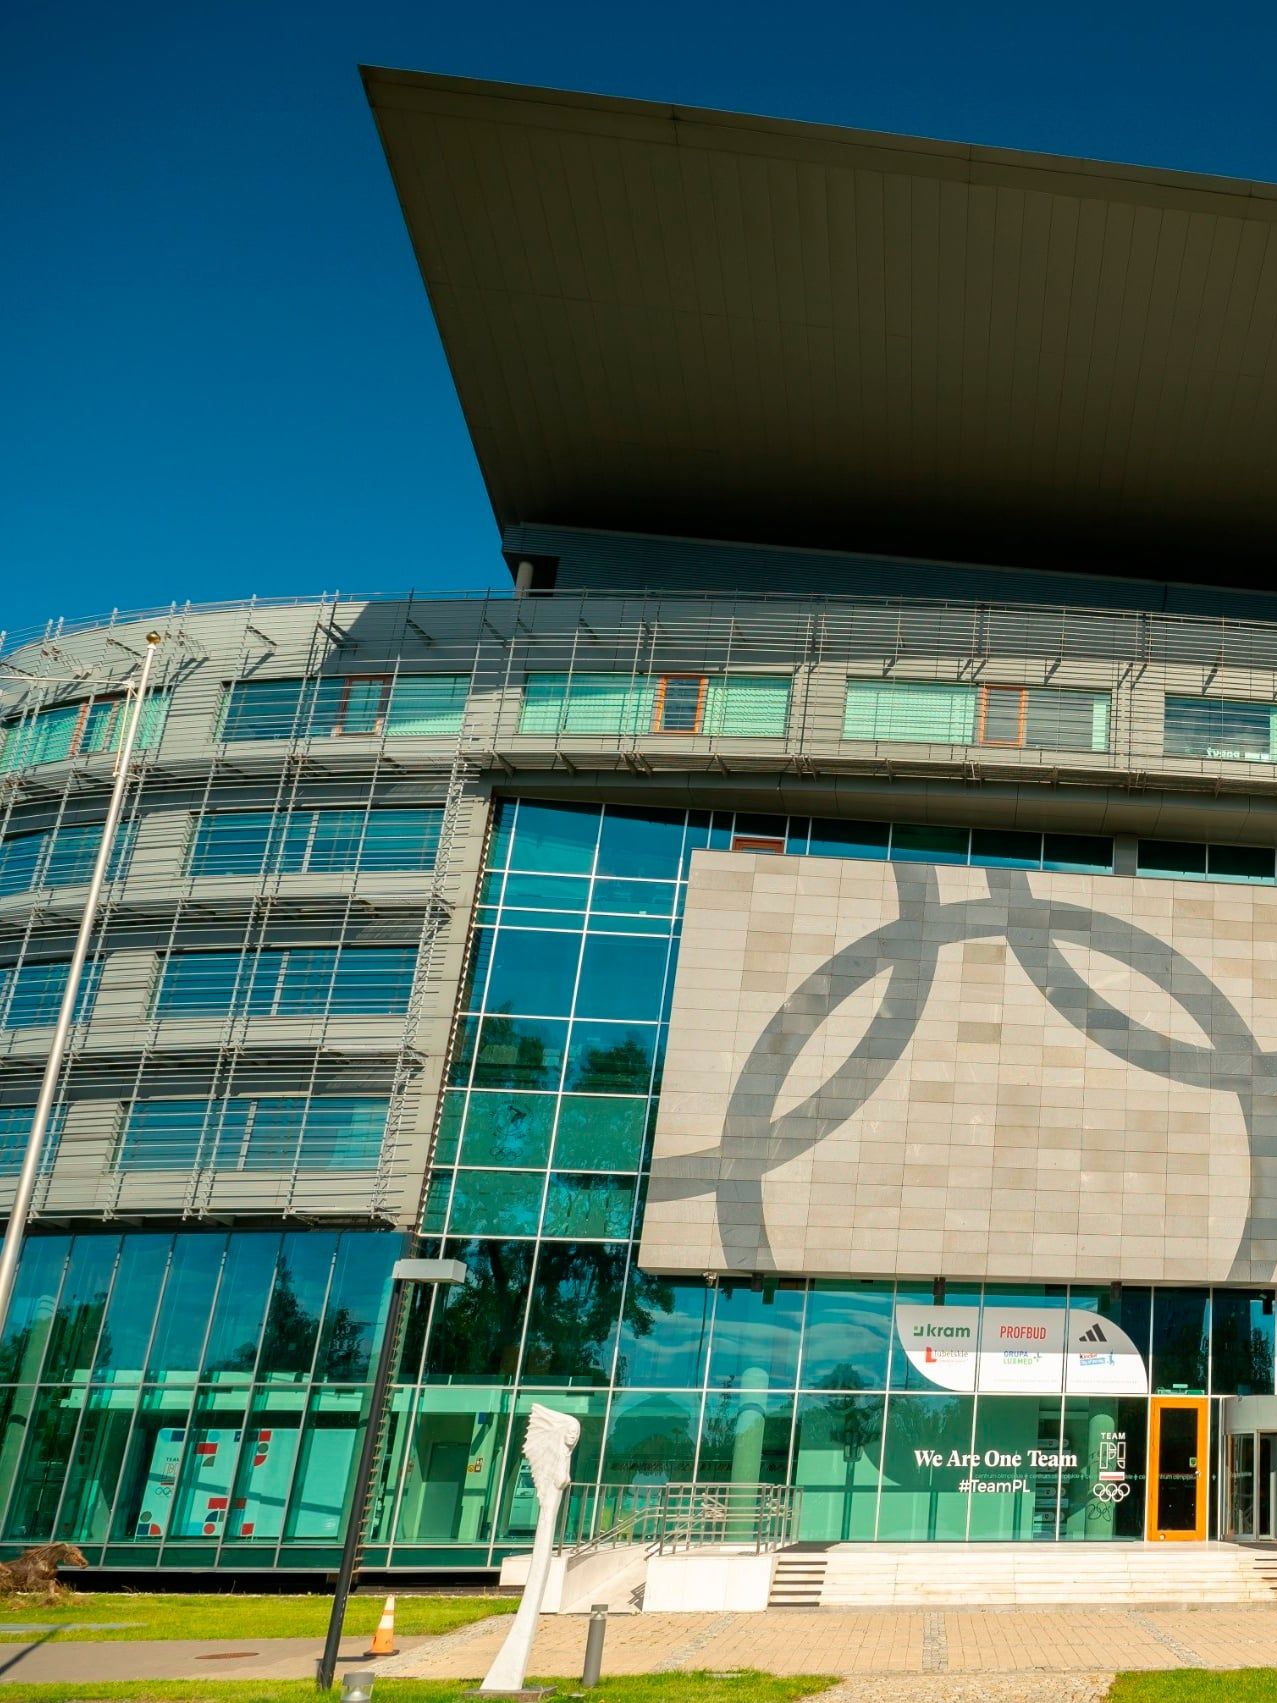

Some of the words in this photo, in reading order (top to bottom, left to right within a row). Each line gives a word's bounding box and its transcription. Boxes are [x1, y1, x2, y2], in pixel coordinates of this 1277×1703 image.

[1000, 1325, 1047, 1340] PROFBUD
[1101, 1432, 1126, 1440] TEAM
[914, 1450, 943, 1468] We
[946, 1450, 980, 1468] Are
[984, 1450, 1022, 1468] One
[1027, 1450, 1078, 1468] Team
[958, 1478, 1031, 1494] #TeamPL
